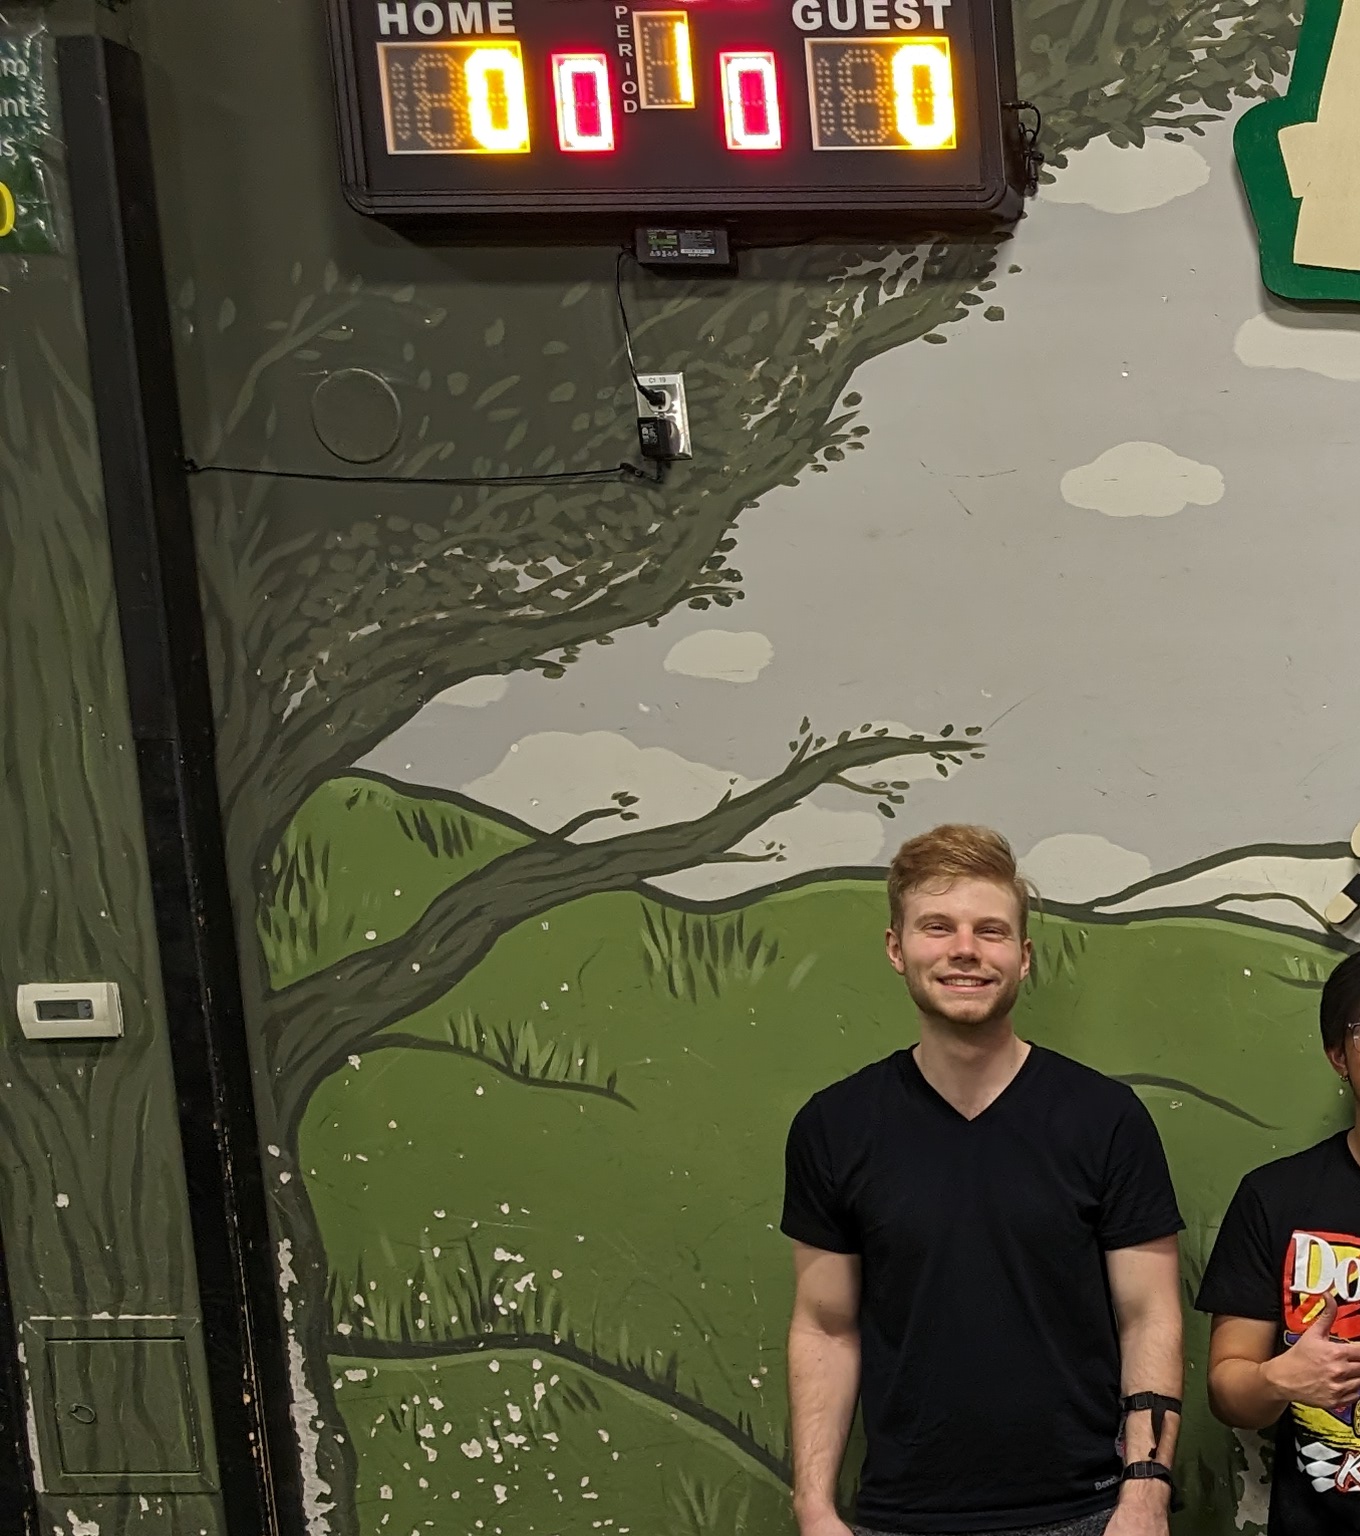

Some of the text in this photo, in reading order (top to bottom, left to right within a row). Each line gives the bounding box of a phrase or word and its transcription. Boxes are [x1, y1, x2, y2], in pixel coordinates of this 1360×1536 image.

[377, 1, 516, 35] HOME
[614, 5, 639, 113] PERIOD
[791, 0, 952, 31] GUEST
[464, 47, 528, 150] 0
[558, 58, 613, 150] 0
[728, 57, 780, 148] 0
[892, 44, 956, 148] 0
